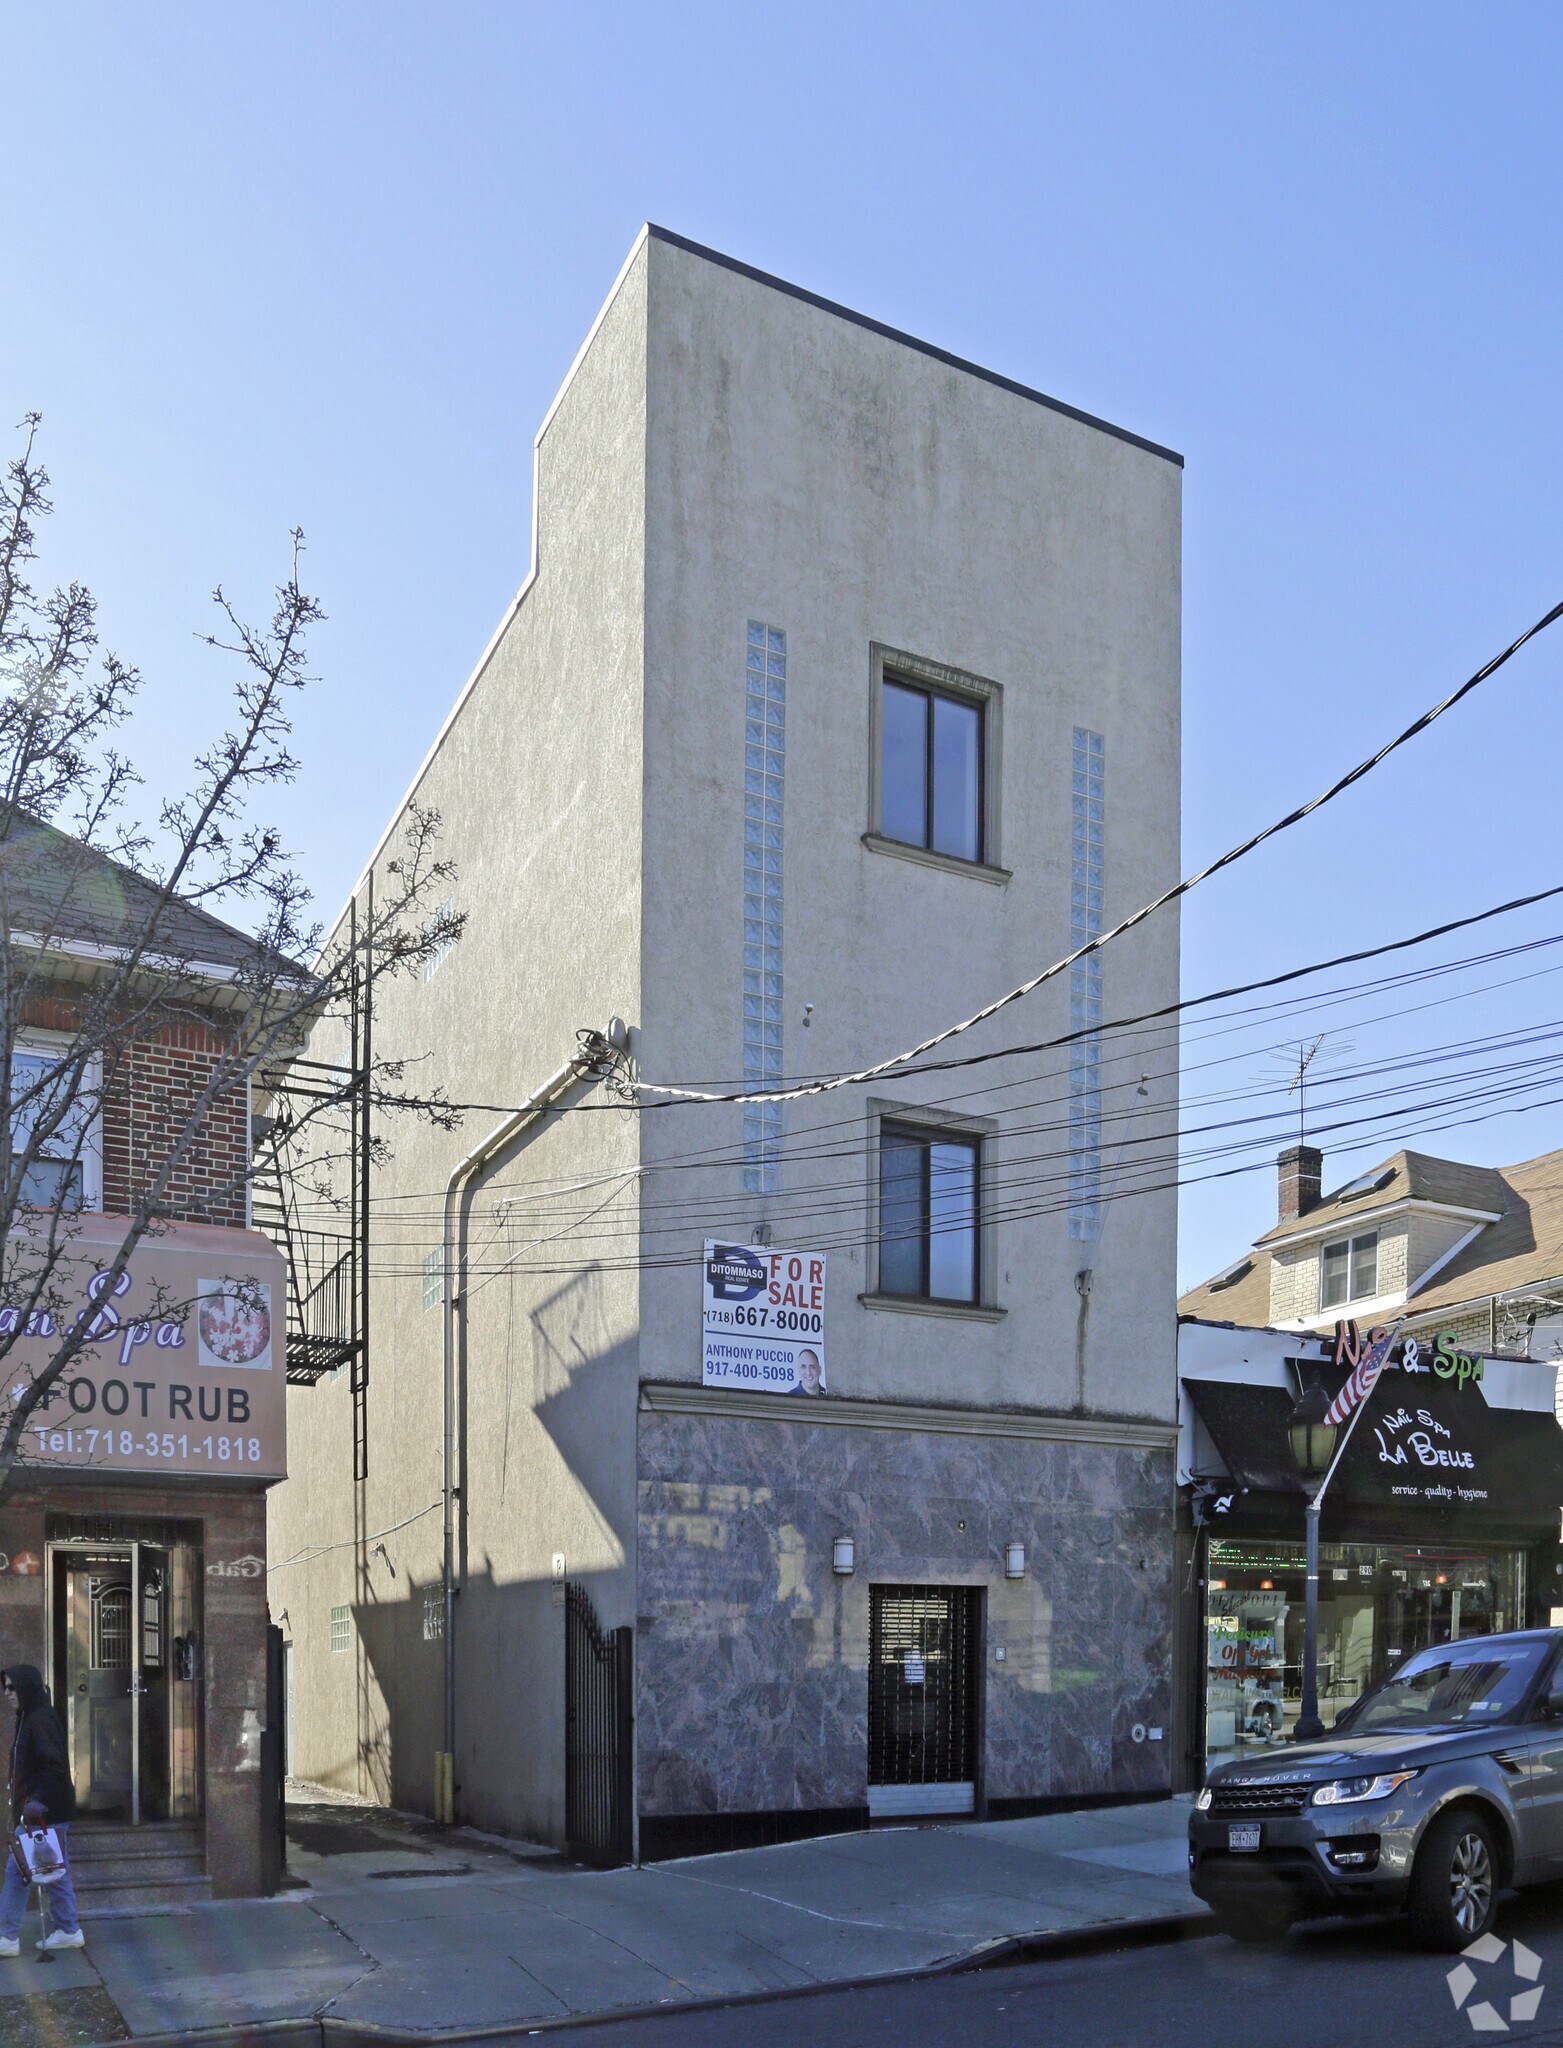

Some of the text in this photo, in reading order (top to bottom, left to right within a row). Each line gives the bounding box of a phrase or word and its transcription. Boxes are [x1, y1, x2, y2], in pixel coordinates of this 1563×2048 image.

[710, 1264, 764, 1280] DITOMMASO
[770, 1254, 823, 1284] FOR
[768, 1281, 823, 1310] SALE
[68, 1268, 185, 1366] Spa
[706, 1344, 794, 1364] ANTHONY PUCCIO
[1402, 1337, 1419, 1373] &
[706, 1361, 795, 1382] 917-400-5098
[42, 1377, 250, 1423] FOOT RUB
[1391, 1484, 1488, 1501] service quality hygiene
[1263, 1773, 1311, 1782] ROVER
